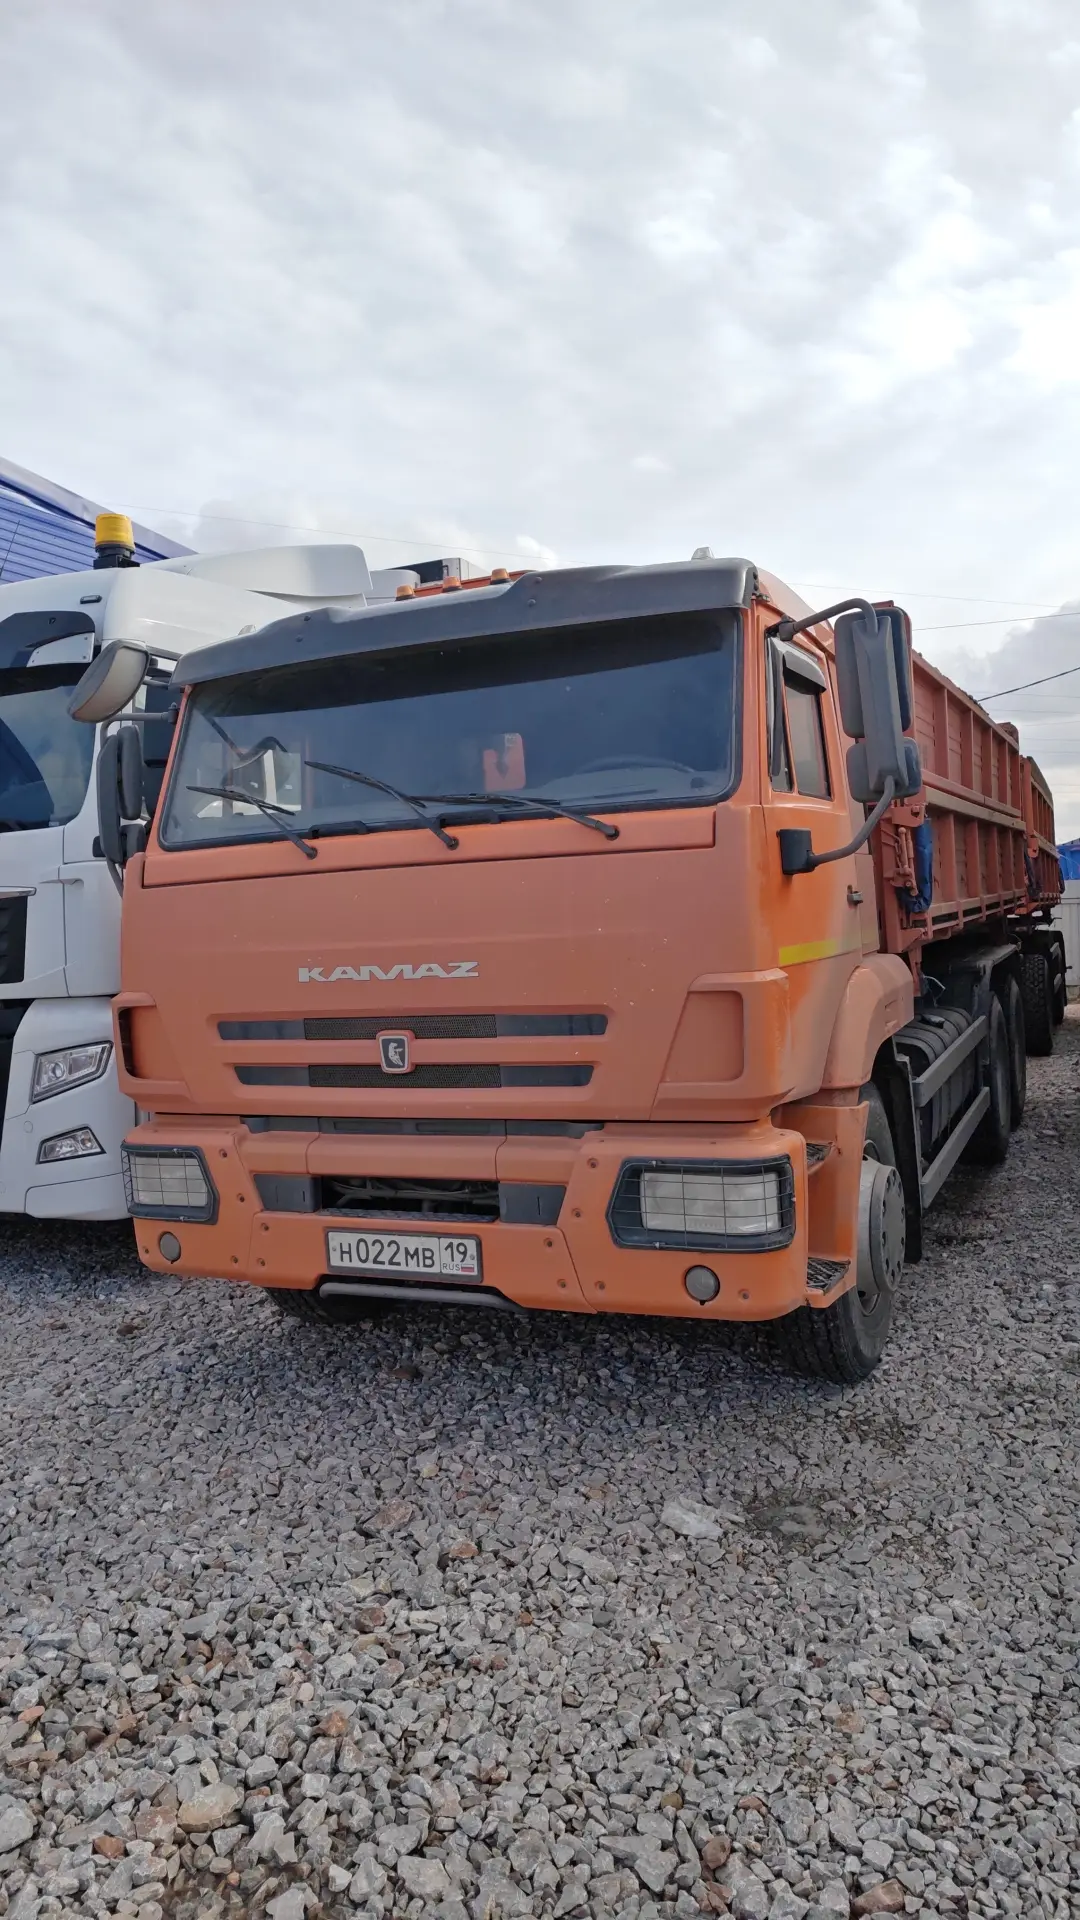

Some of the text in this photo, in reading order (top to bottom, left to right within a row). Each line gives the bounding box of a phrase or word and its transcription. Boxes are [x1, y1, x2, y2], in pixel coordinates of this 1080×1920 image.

[298, 961, 479, 982] KAMAZ
[444, 1241, 468, 1263] 19
[442, 1263, 460, 1271] RUS
